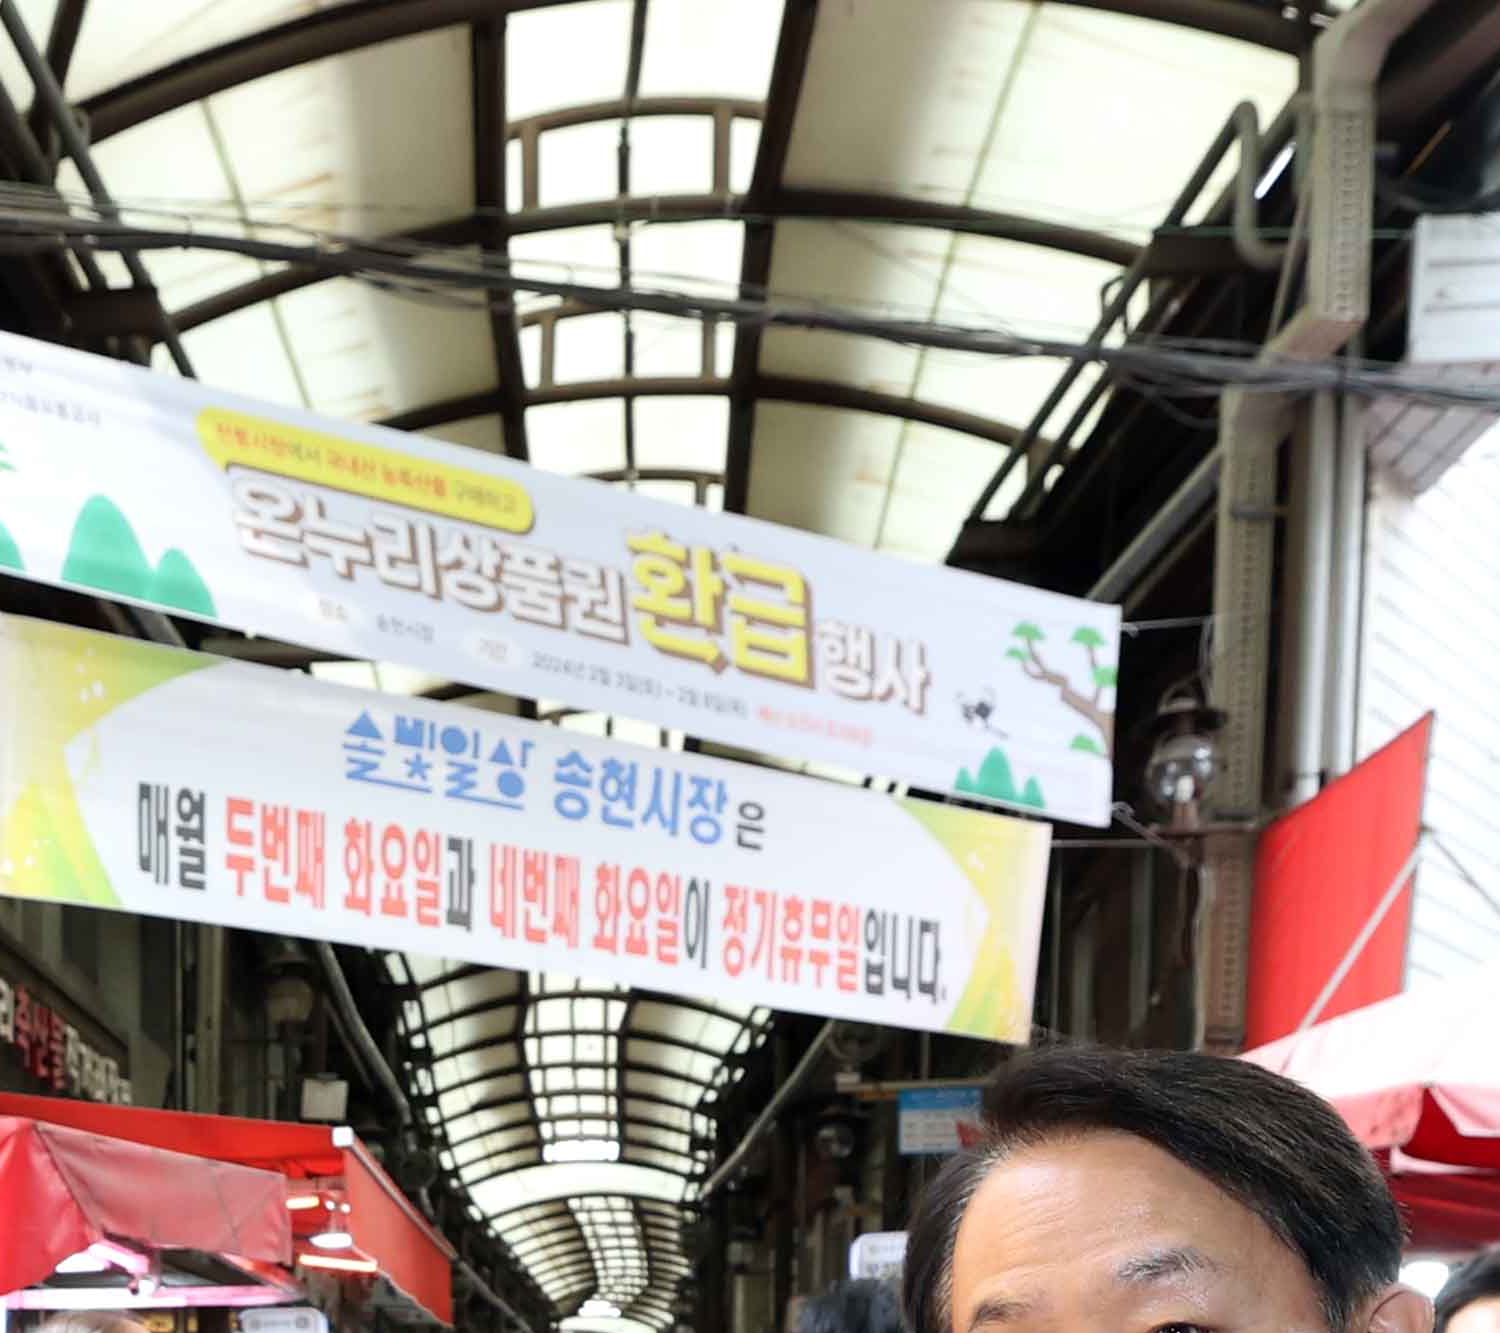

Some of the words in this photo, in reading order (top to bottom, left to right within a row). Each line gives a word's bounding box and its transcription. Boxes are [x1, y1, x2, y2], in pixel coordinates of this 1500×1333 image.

[232, 476, 630, 645] 온누리상품권
[627, 531, 815, 690] 환급
[818, 620, 931, 715] 행사
[138, 781, 207, 890] 매월
[225, 796, 327, 910] 두번째
[343, 816, 475, 932] 화요일과
[488, 840, 581, 950] 네번째
[593, 863, 709, 970] 화요일이
[720, 882, 948, 1005] 정기휴무일입니다.
[552, 748, 766, 851] 송현시장은
